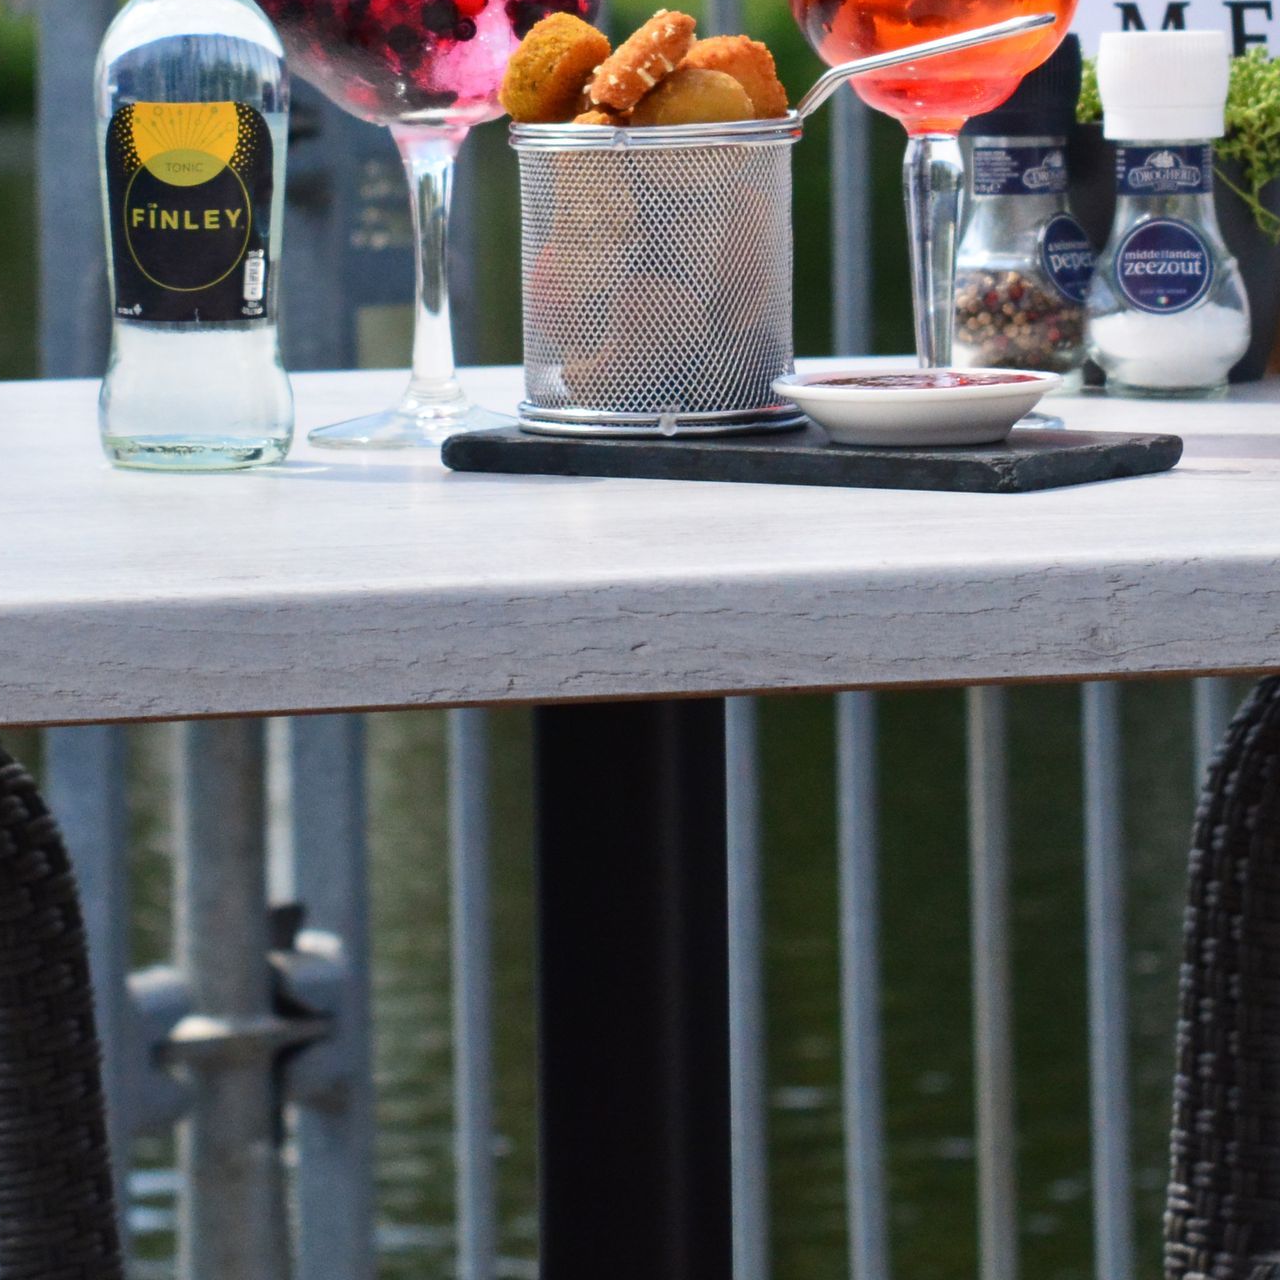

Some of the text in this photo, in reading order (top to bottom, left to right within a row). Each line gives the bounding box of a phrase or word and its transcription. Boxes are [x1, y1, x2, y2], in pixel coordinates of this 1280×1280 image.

[165, 161, 204, 173] TONIC
[1125, 250, 1203, 260] middellandse
[1124, 260, 1203, 276] zeezout
